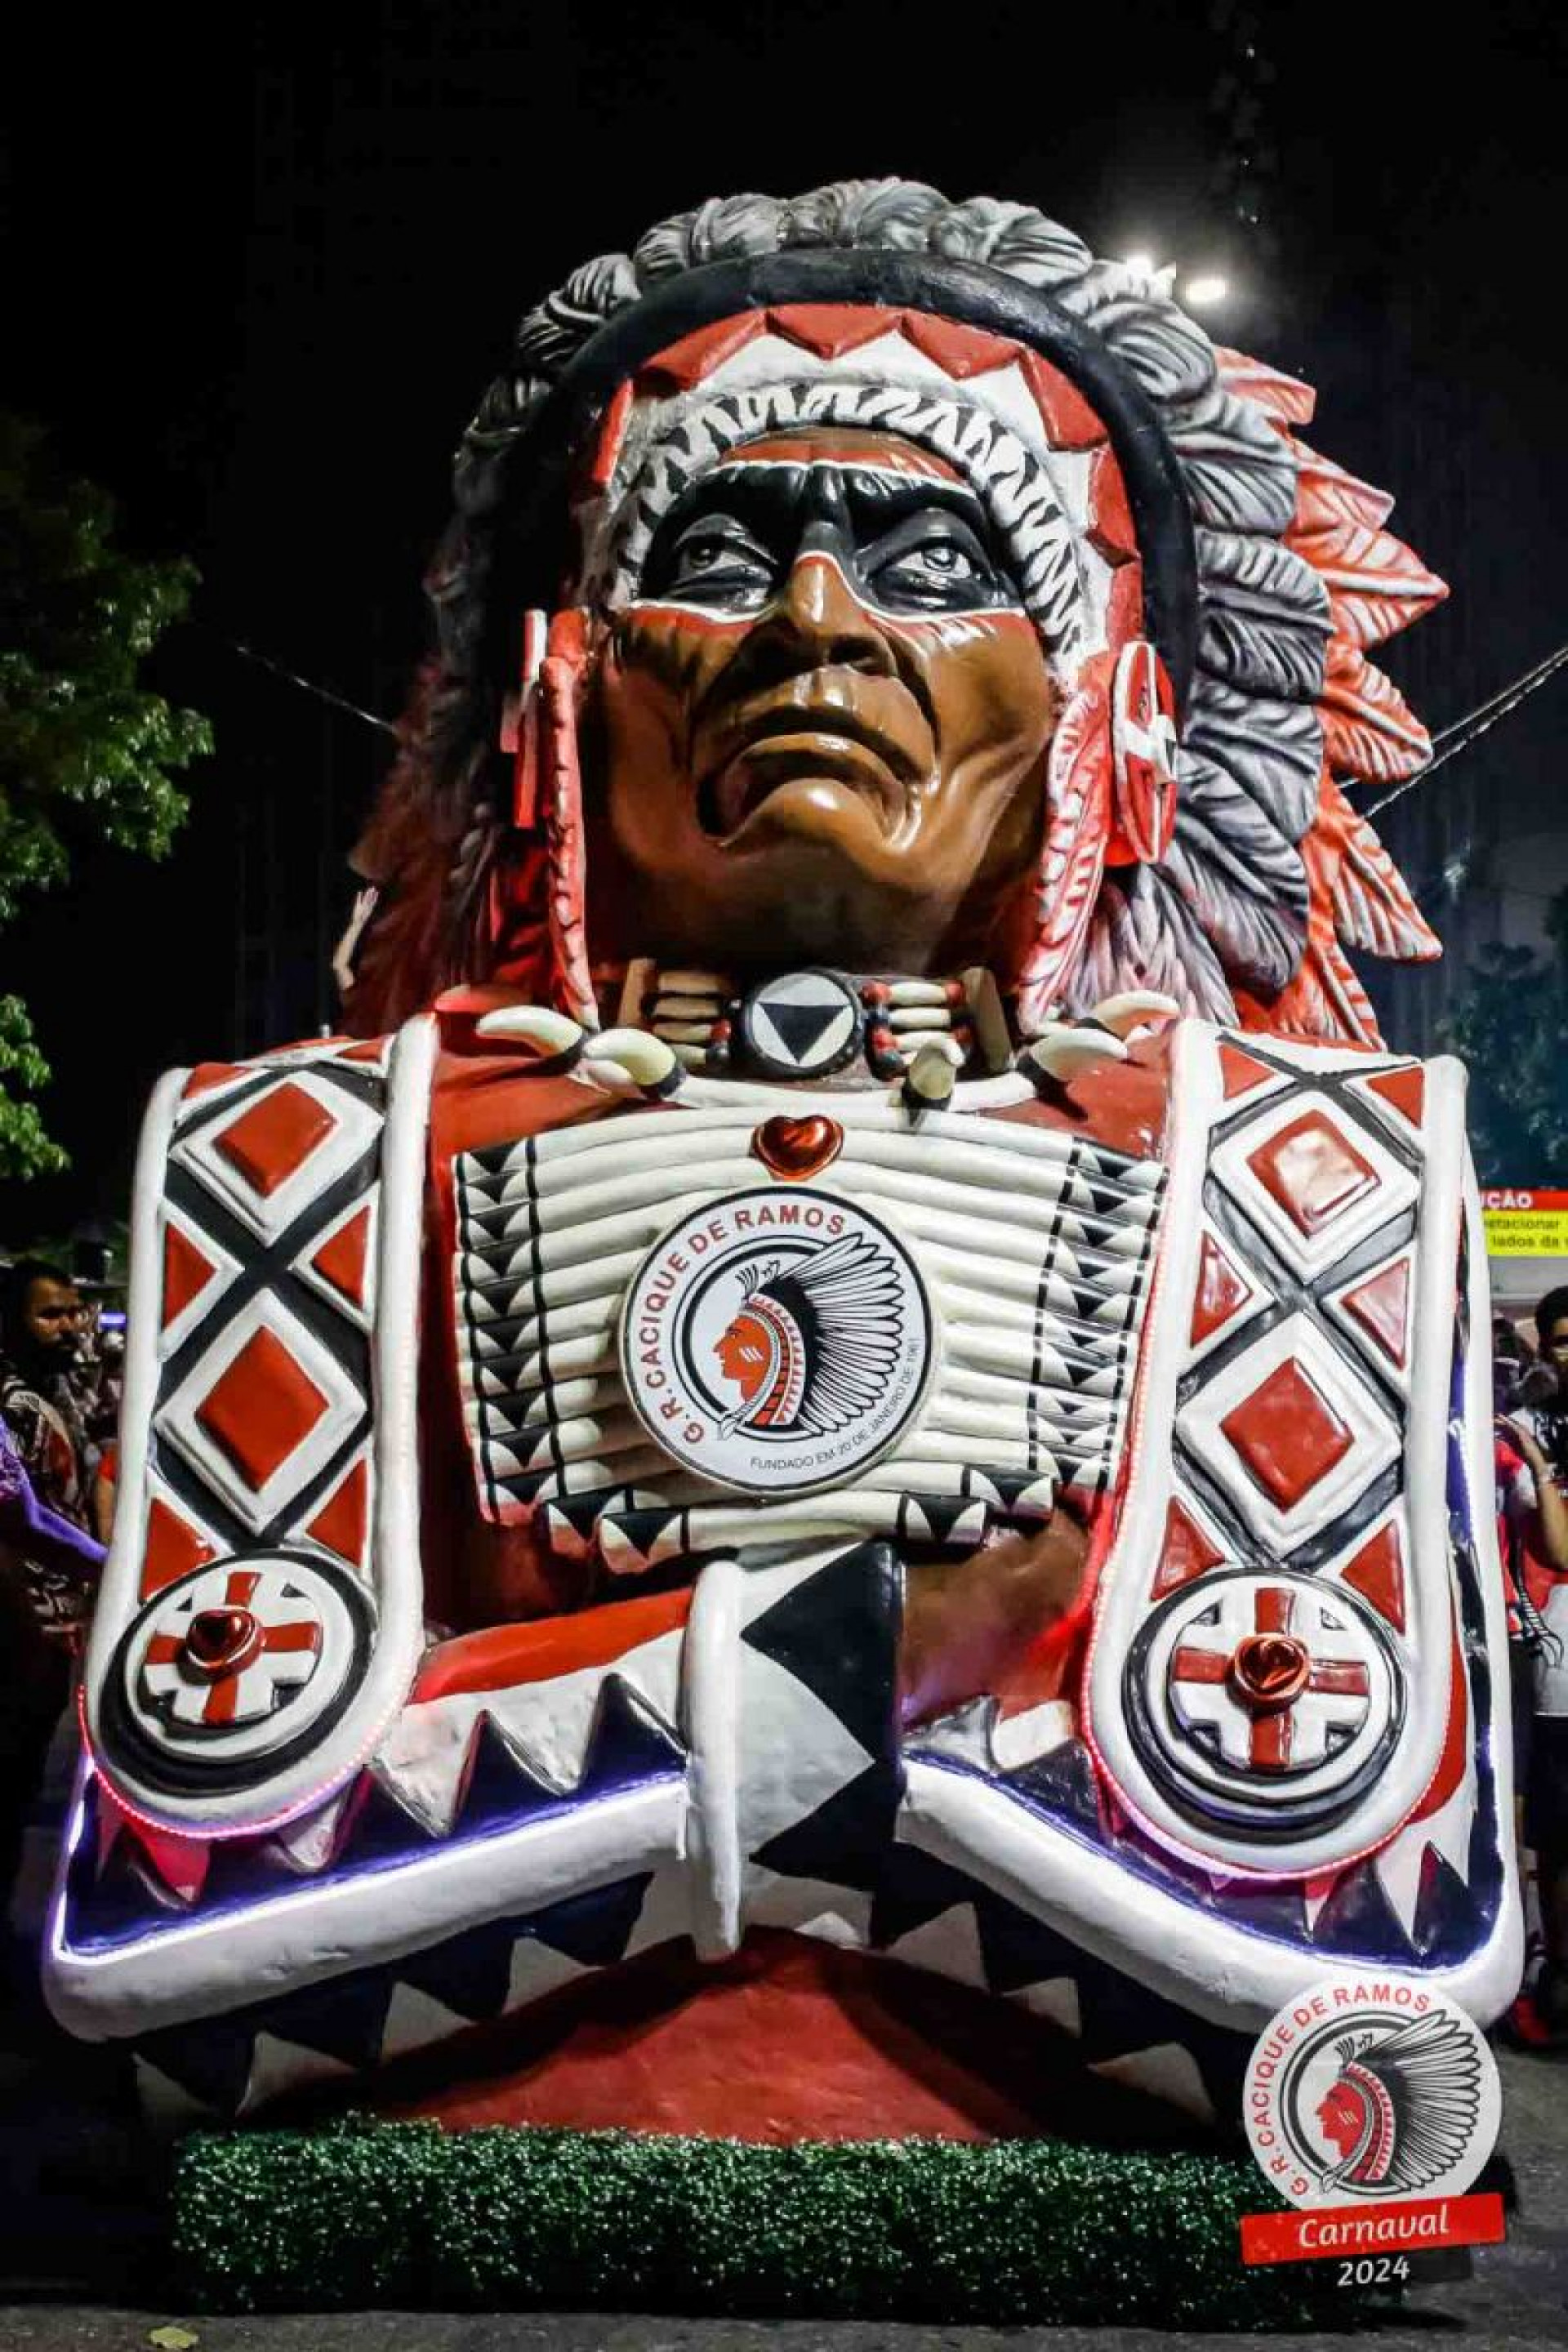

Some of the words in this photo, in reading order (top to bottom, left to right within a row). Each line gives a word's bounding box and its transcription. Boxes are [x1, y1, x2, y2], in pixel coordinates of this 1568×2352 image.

[639, 1253, 690, 1389] CACIQUE
[688, 1219, 727, 1254] DE
[734, 1205, 847, 1236] RAMOS
[749, 1455, 814, 1470] FUNDADO
[817, 1449, 835, 1463] EM
[868, 1386, 906, 1432] JANEIRO
[900, 1366, 915, 1385] DE
